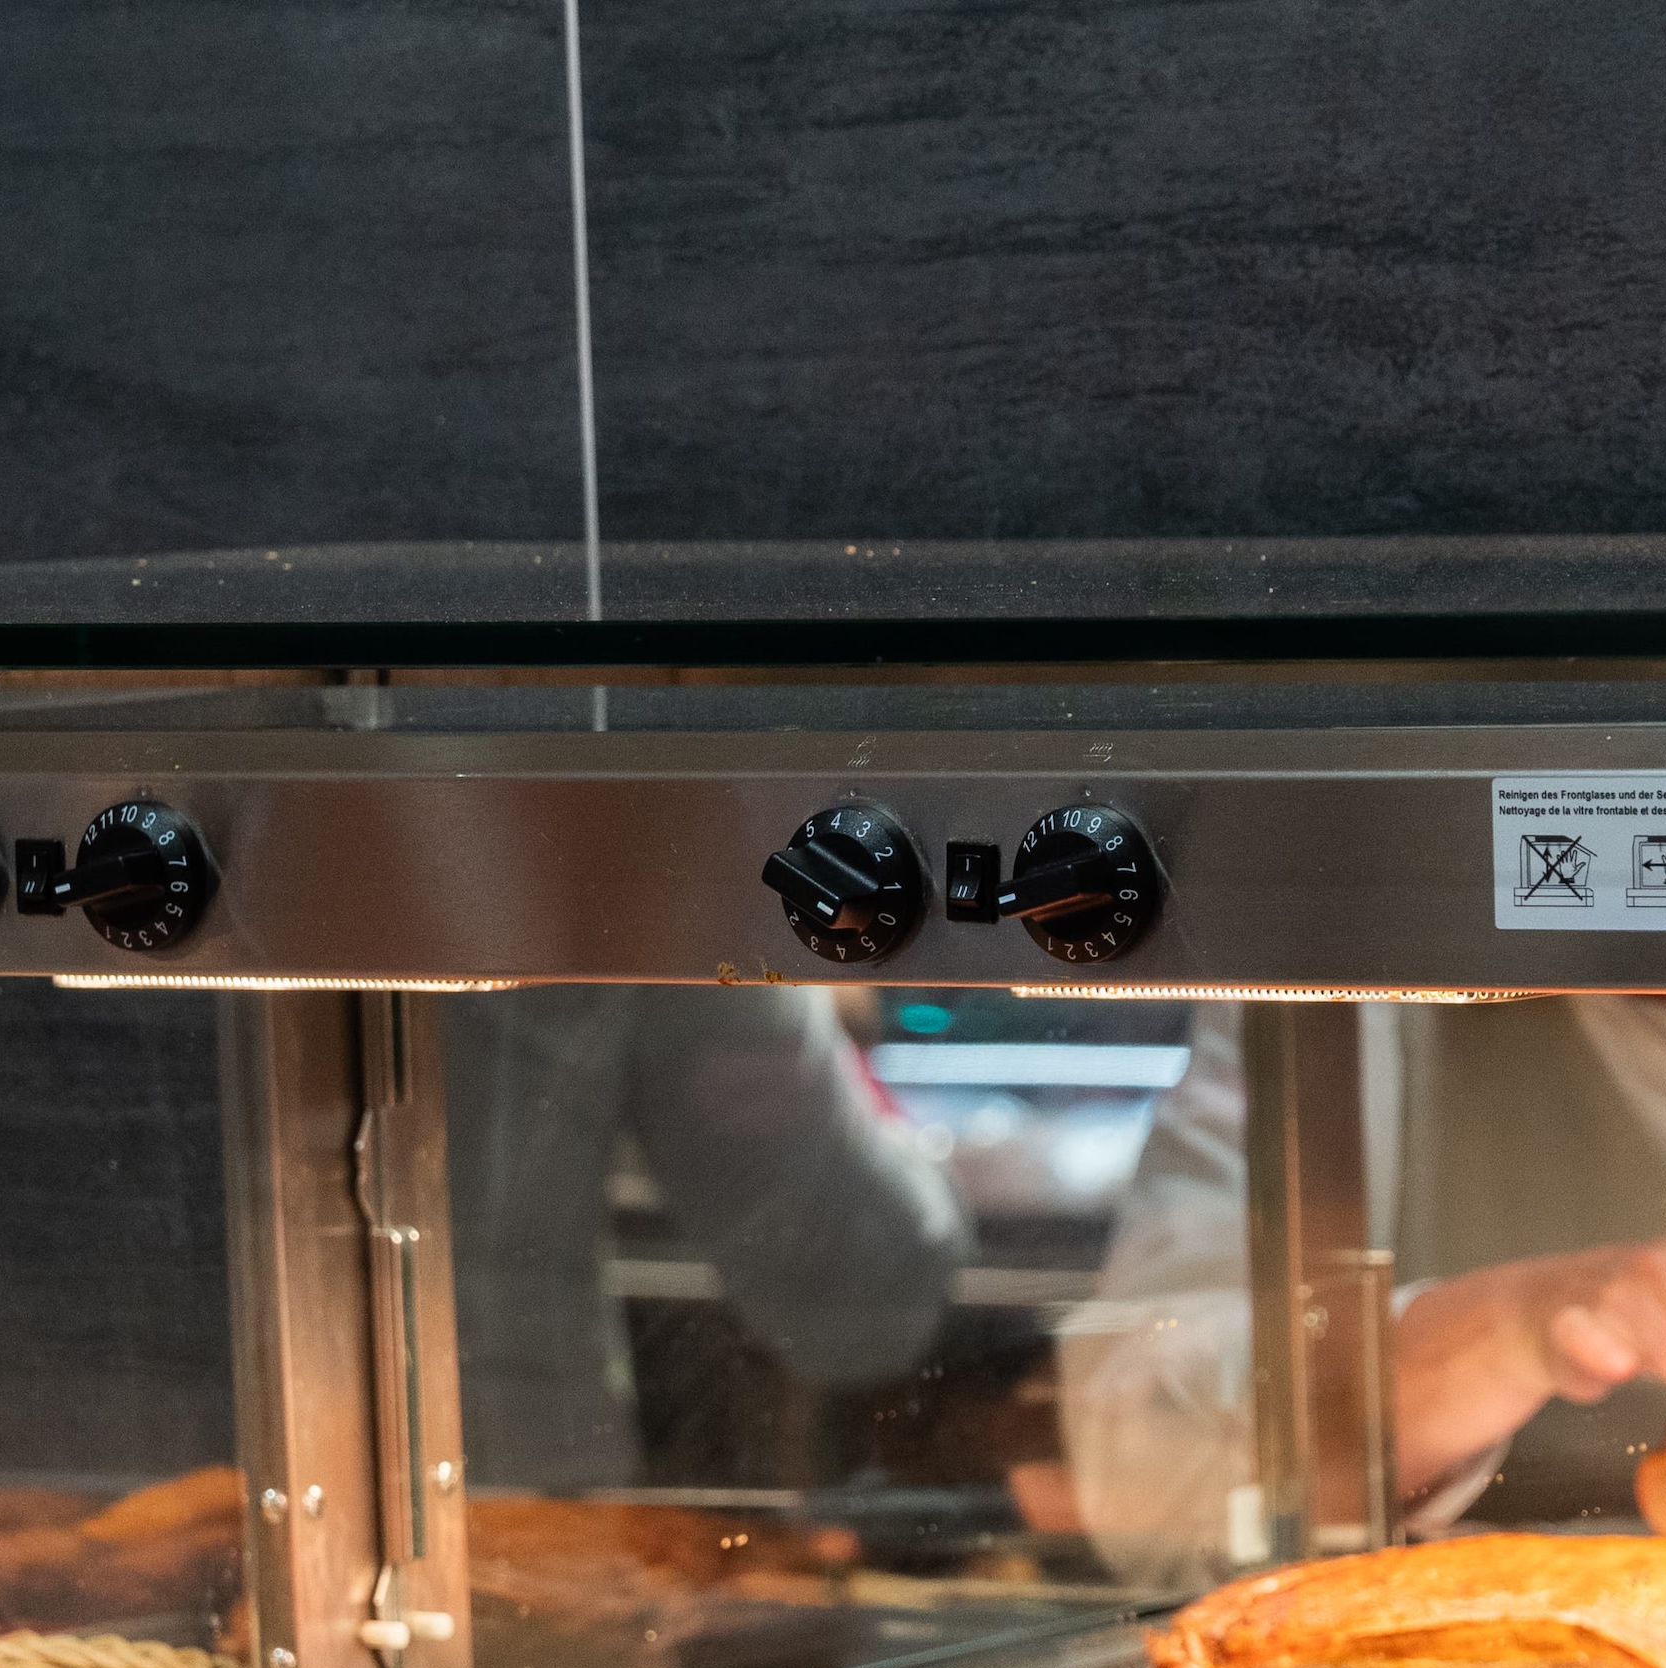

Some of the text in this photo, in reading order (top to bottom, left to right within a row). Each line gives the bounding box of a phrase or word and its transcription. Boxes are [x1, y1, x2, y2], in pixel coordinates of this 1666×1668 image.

[1498, 789, 1539, 801] Reinigen
[1541, 789, 1558, 799] des
[1560, 789, 1615, 801] Frontglases
[1618, 789, 1635, 799] und
[1638, 789, 1654, 799] der
[1499, 805, 1546, 817] Nettoyage
[1548, 805, 1560, 815] de
[1562, 805, 1570, 815] la
[1572, 805, 1593, 815] vitre
[1595, 805, 1638, 815] frontable
[1640, 805, 1648, 815] et
[84, 805, 189, 948] 12 11 10 9 8 7 6 5 4 3 2 1
[789, 812, 902, 959] 5 4 3 2 1 0 5 4 3 2
[1022, 810, 1138, 960] 12 11 10 9 8 7 6 5 4 3 2 1
